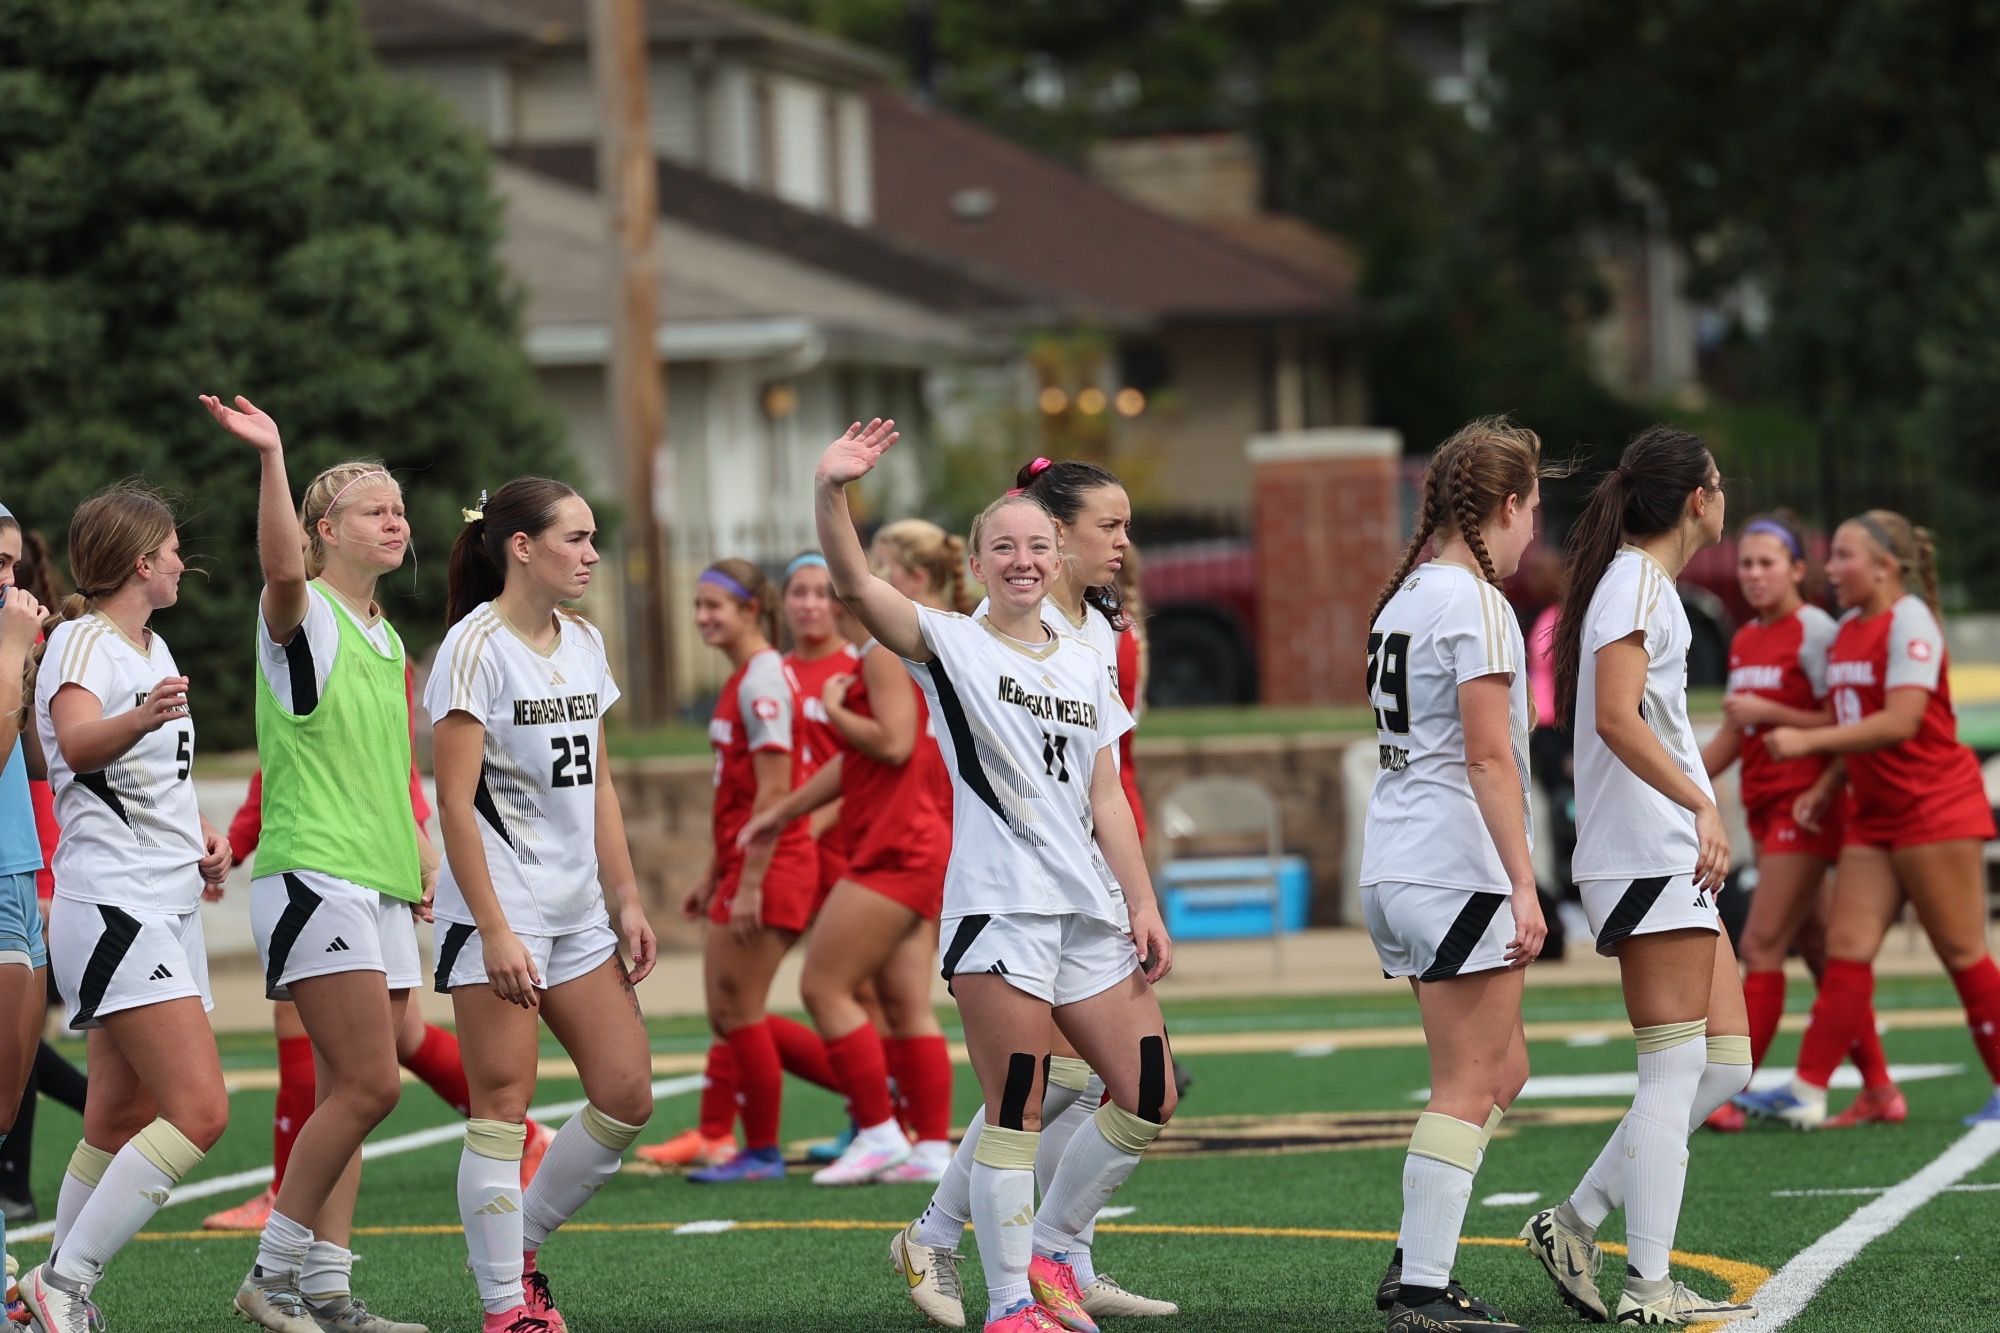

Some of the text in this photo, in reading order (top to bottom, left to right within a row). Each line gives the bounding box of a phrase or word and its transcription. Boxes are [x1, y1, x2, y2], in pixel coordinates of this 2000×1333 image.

[513, 697, 566, 726] NEBRASKA
[176, 730, 191, 781] 5
[550, 733, 593, 788] 23
